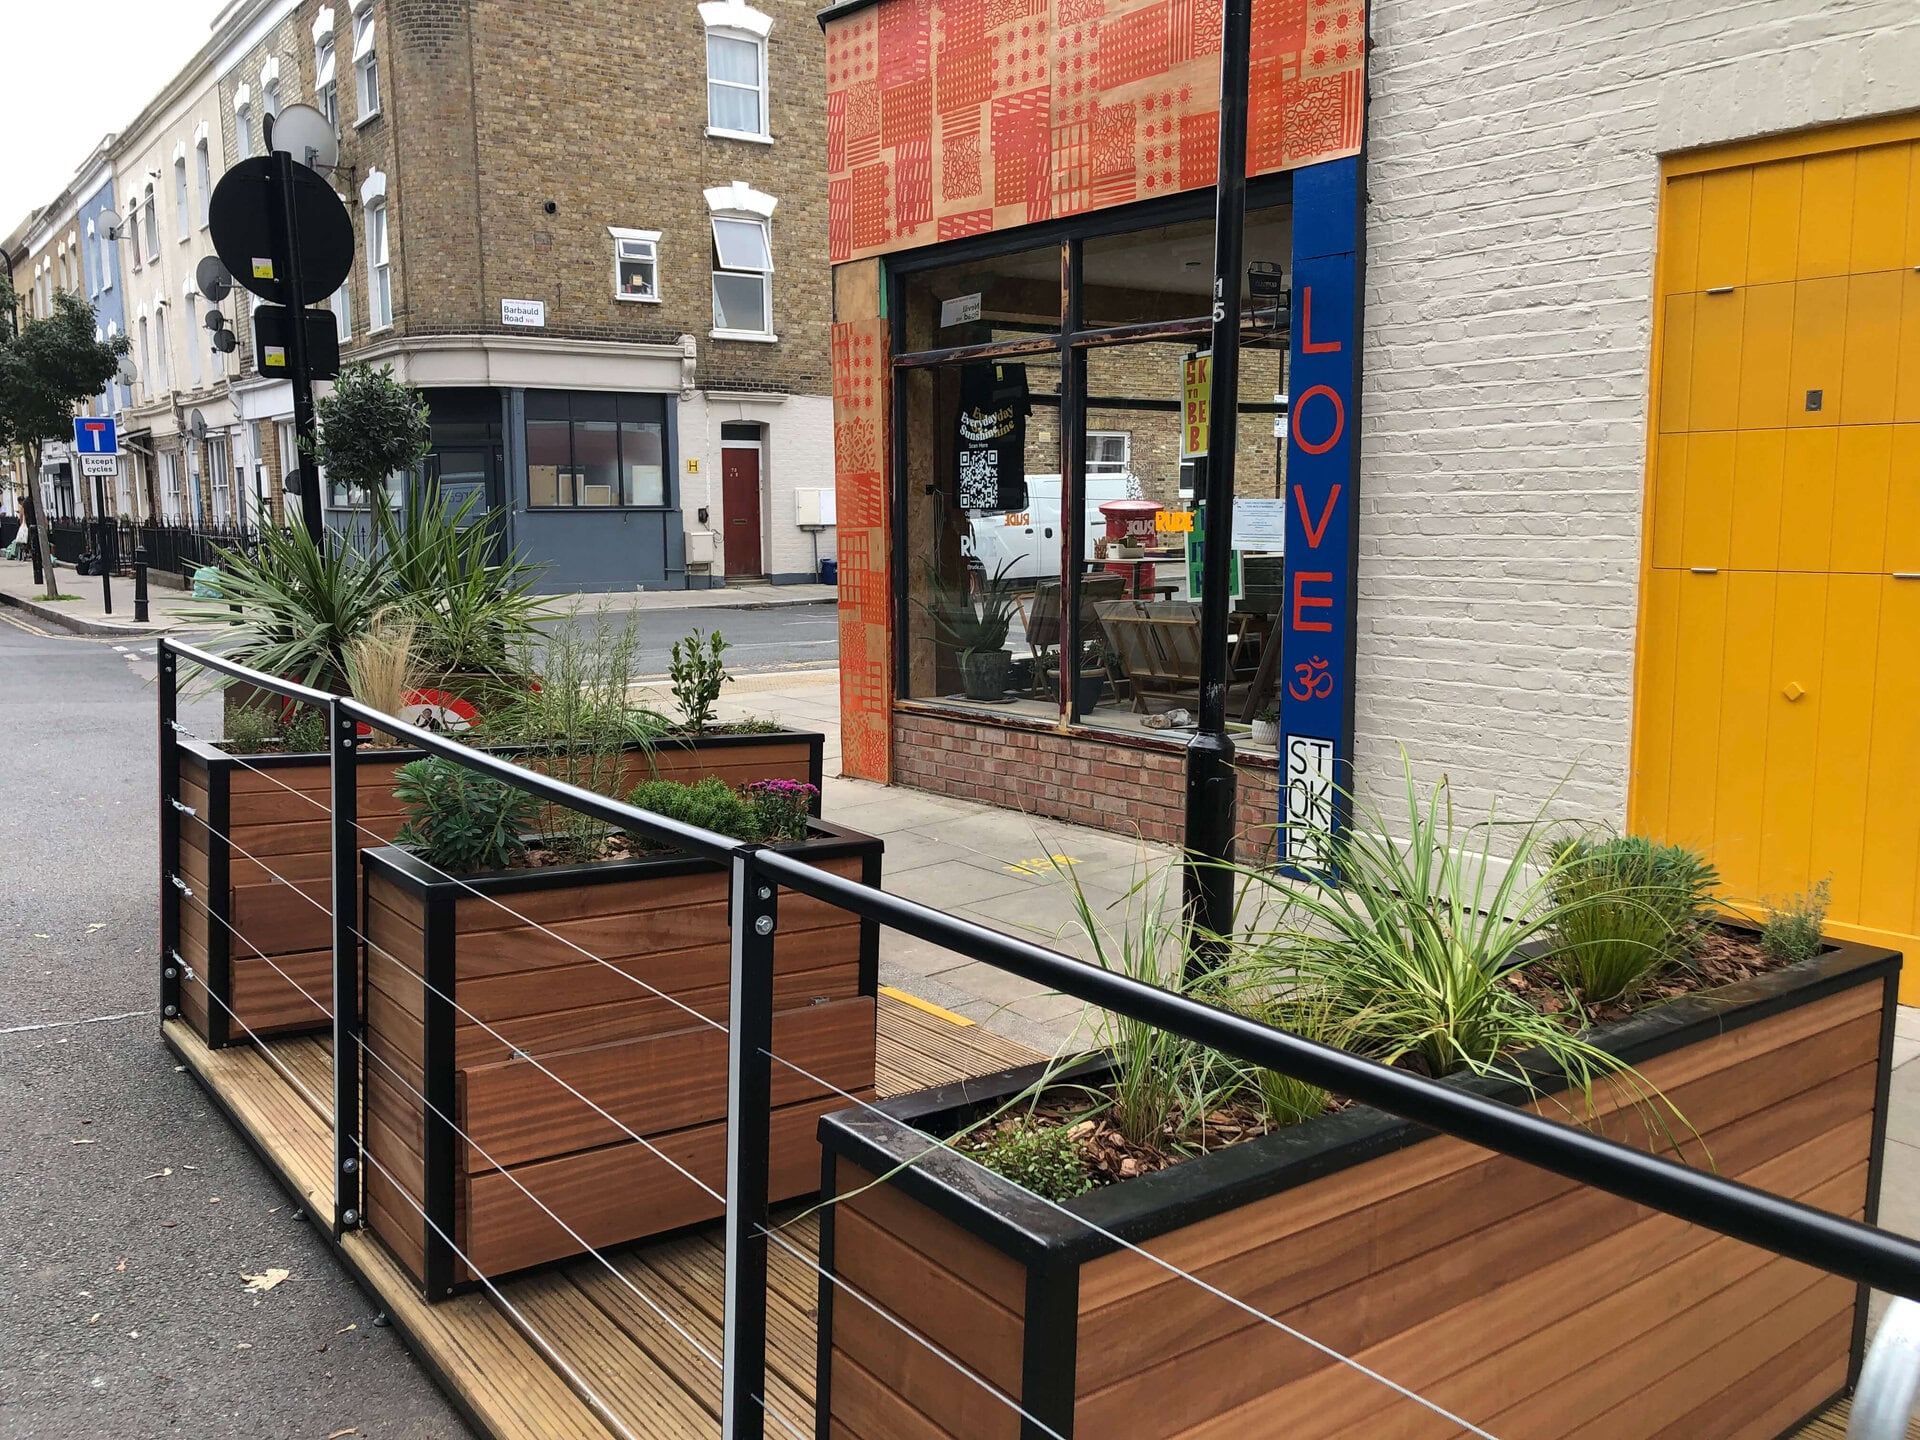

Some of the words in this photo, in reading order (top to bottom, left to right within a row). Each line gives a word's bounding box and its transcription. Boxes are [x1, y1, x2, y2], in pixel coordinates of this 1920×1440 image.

[503, 305, 539, 316] Barbauld
[504, 314, 524, 323] Road
[1292, 287, 1344, 632] LOVE
[87, 465, 113, 473] cycles
[688, 460, 698, 472] H
[1155, 511, 1195, 533] RUDE
